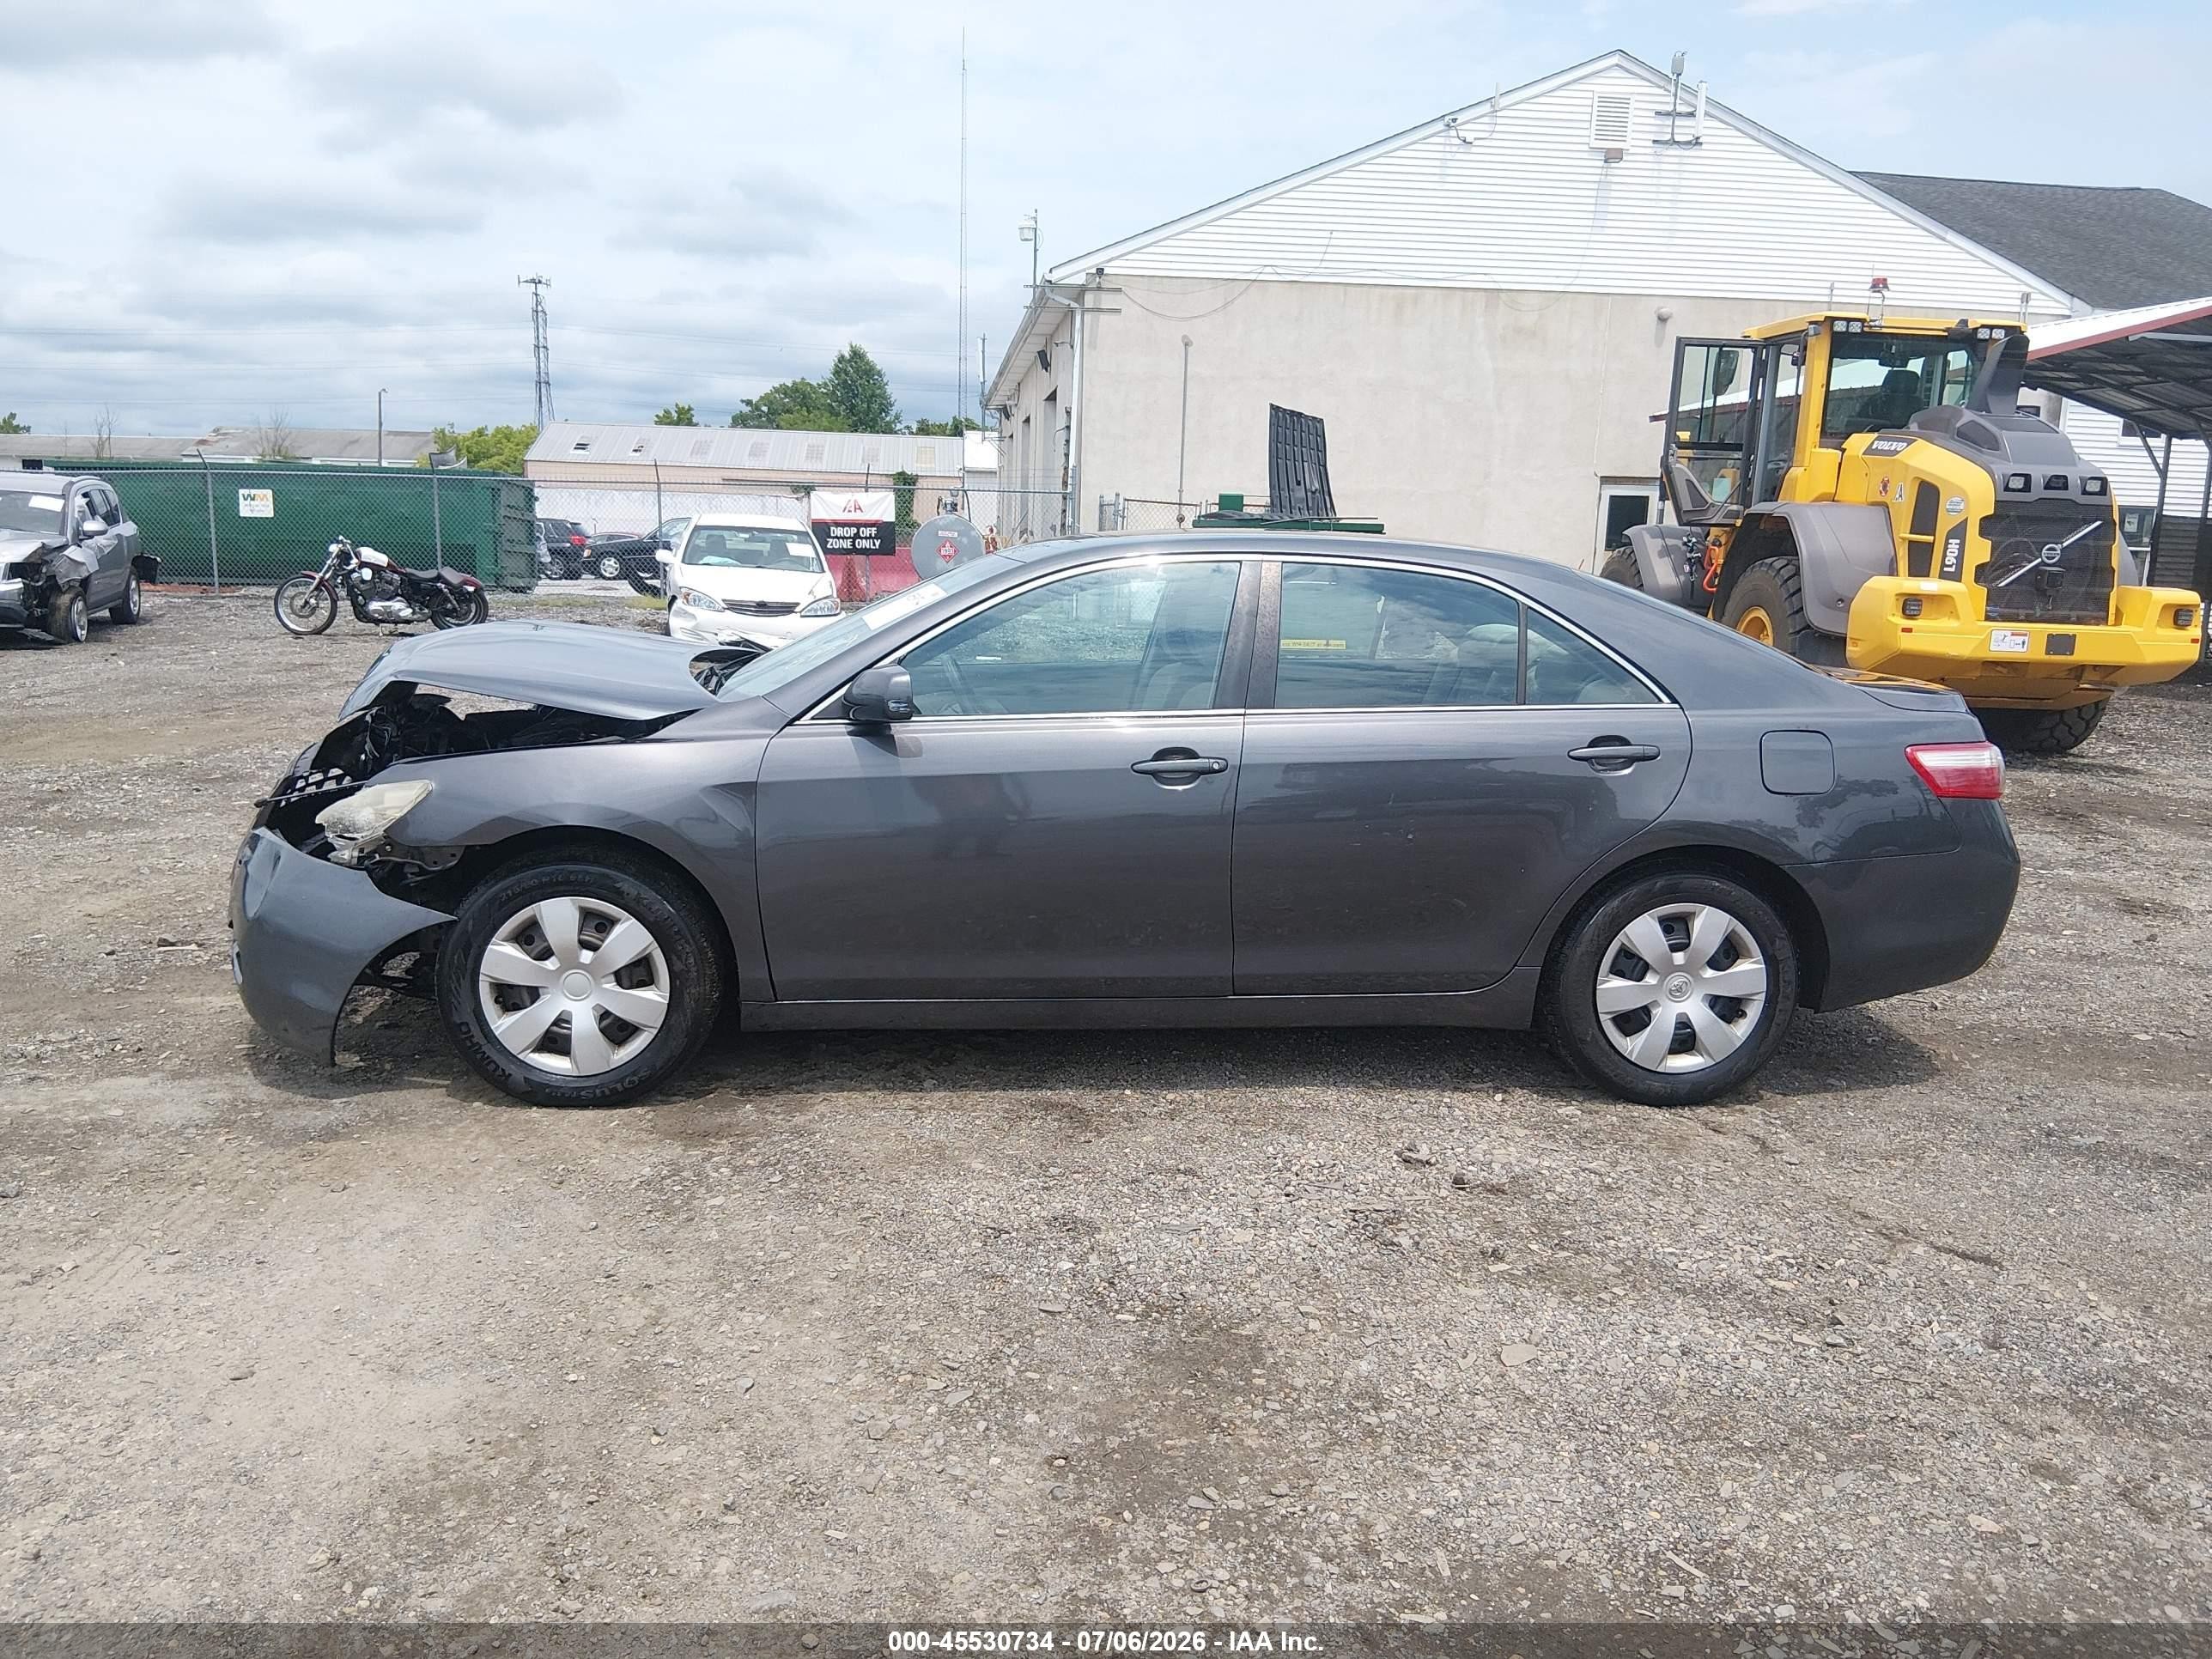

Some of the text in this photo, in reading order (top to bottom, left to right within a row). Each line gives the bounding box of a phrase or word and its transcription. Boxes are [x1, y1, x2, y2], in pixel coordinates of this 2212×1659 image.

[1872, 440, 1907, 451] VOLVO
[830, 526, 878, 538] DROP OFF
[826, 538, 881, 550] ZONE ONLY
[1943, 538, 1960, 573] L90H
[458, 1021, 514, 1080] KUMHO
